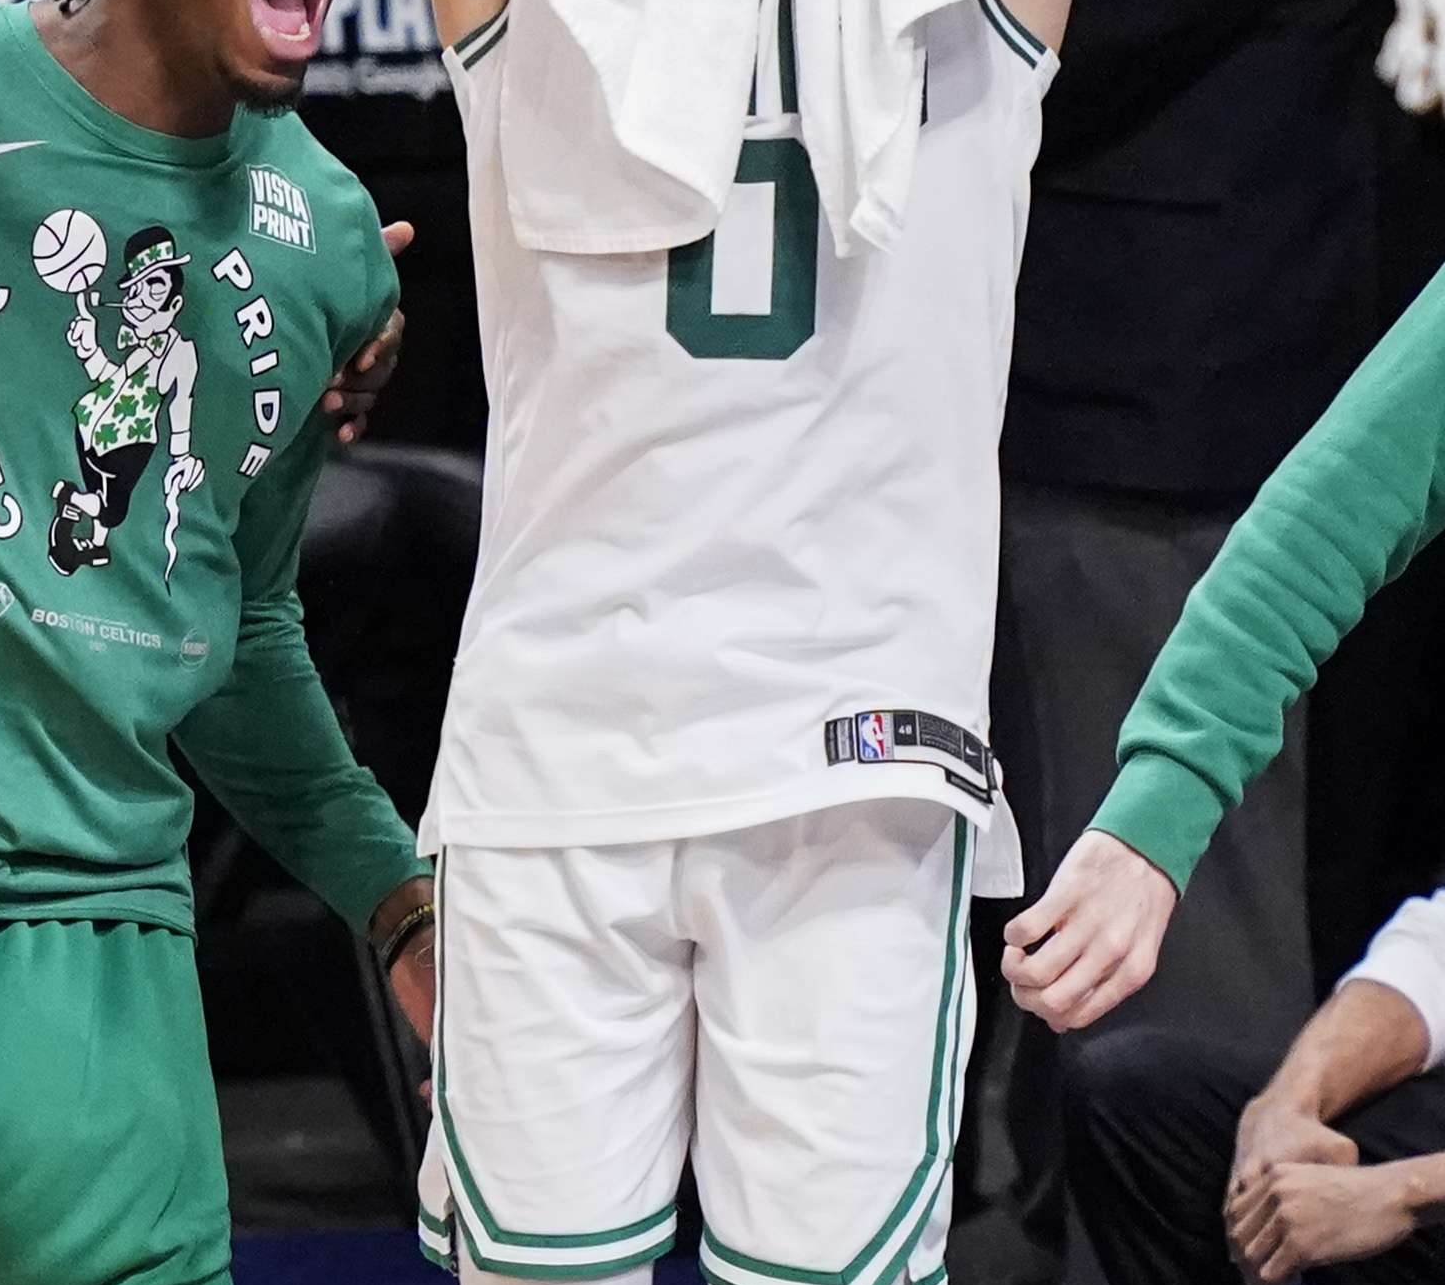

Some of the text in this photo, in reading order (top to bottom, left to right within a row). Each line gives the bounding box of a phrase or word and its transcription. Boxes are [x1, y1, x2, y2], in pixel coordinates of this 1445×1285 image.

[251, 169, 309, 222] VISTA
[253, 203, 311, 248] PRINT
[210, 246, 282, 480] PRIDE
[31, 608, 95, 636] BOSTON
[99, 624, 162, 649] CELTICS
